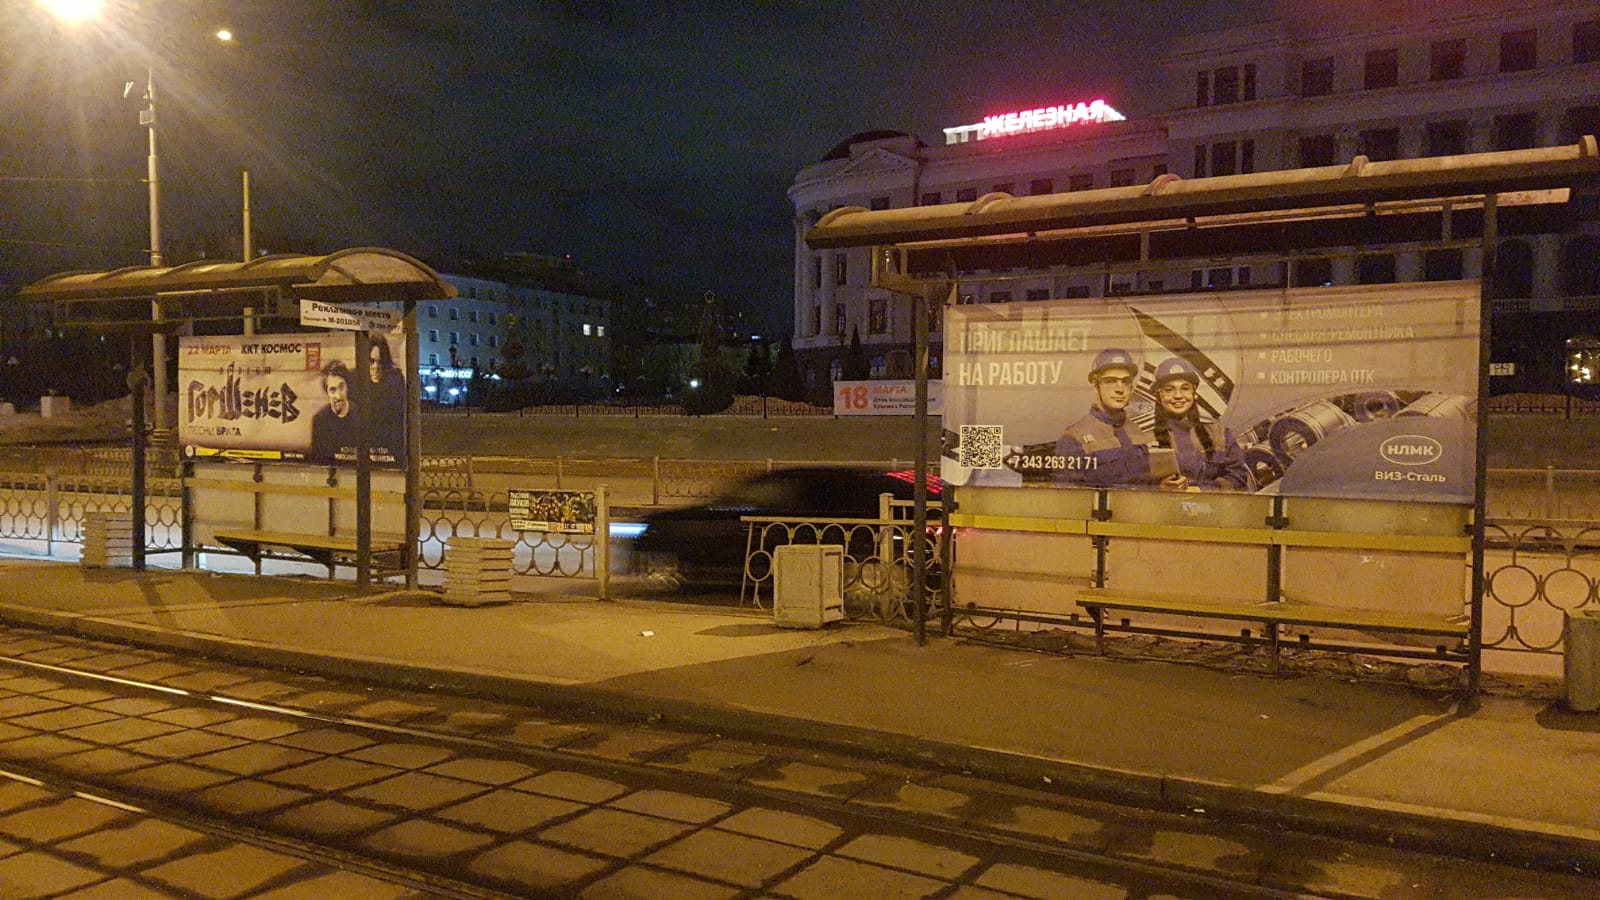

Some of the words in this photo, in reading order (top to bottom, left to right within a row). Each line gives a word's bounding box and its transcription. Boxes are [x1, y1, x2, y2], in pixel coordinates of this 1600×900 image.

[983, 99, 1105, 135] ЖЕЛЕЗНАЯ
[311, 303, 363, 316] Рекламное
[960, 327, 1091, 353] ПРИГЛАШАЕТ
[187, 345, 199, 355] 22
[201, 344, 232, 355] МАРТА
[261, 343, 302, 354] КОСМОС
[1271, 349, 1332, 364] РАБОЧЕГО
[959, 362, 984, 386] НА
[988, 360, 1063, 386] РАБОТУ
[1270, 369, 1348, 384] КОНТРОЛЕРА
[1350, 369, 1375, 383] ОТК
[841, 386, 869, 410] 18
[216, 426, 242, 437] БРАТА
[1387, 445, 1434, 456] НЛМК
[1007, 455, 1020, 468] +7
[1022, 456, 1042, 469] 343
[1045, 456, 1065, 469] 263
[1068, 456, 1081, 470] 21
[1083, 457, 1098, 470] 71
[1374, 471, 1447, 483] ВИЗ-Сталь
